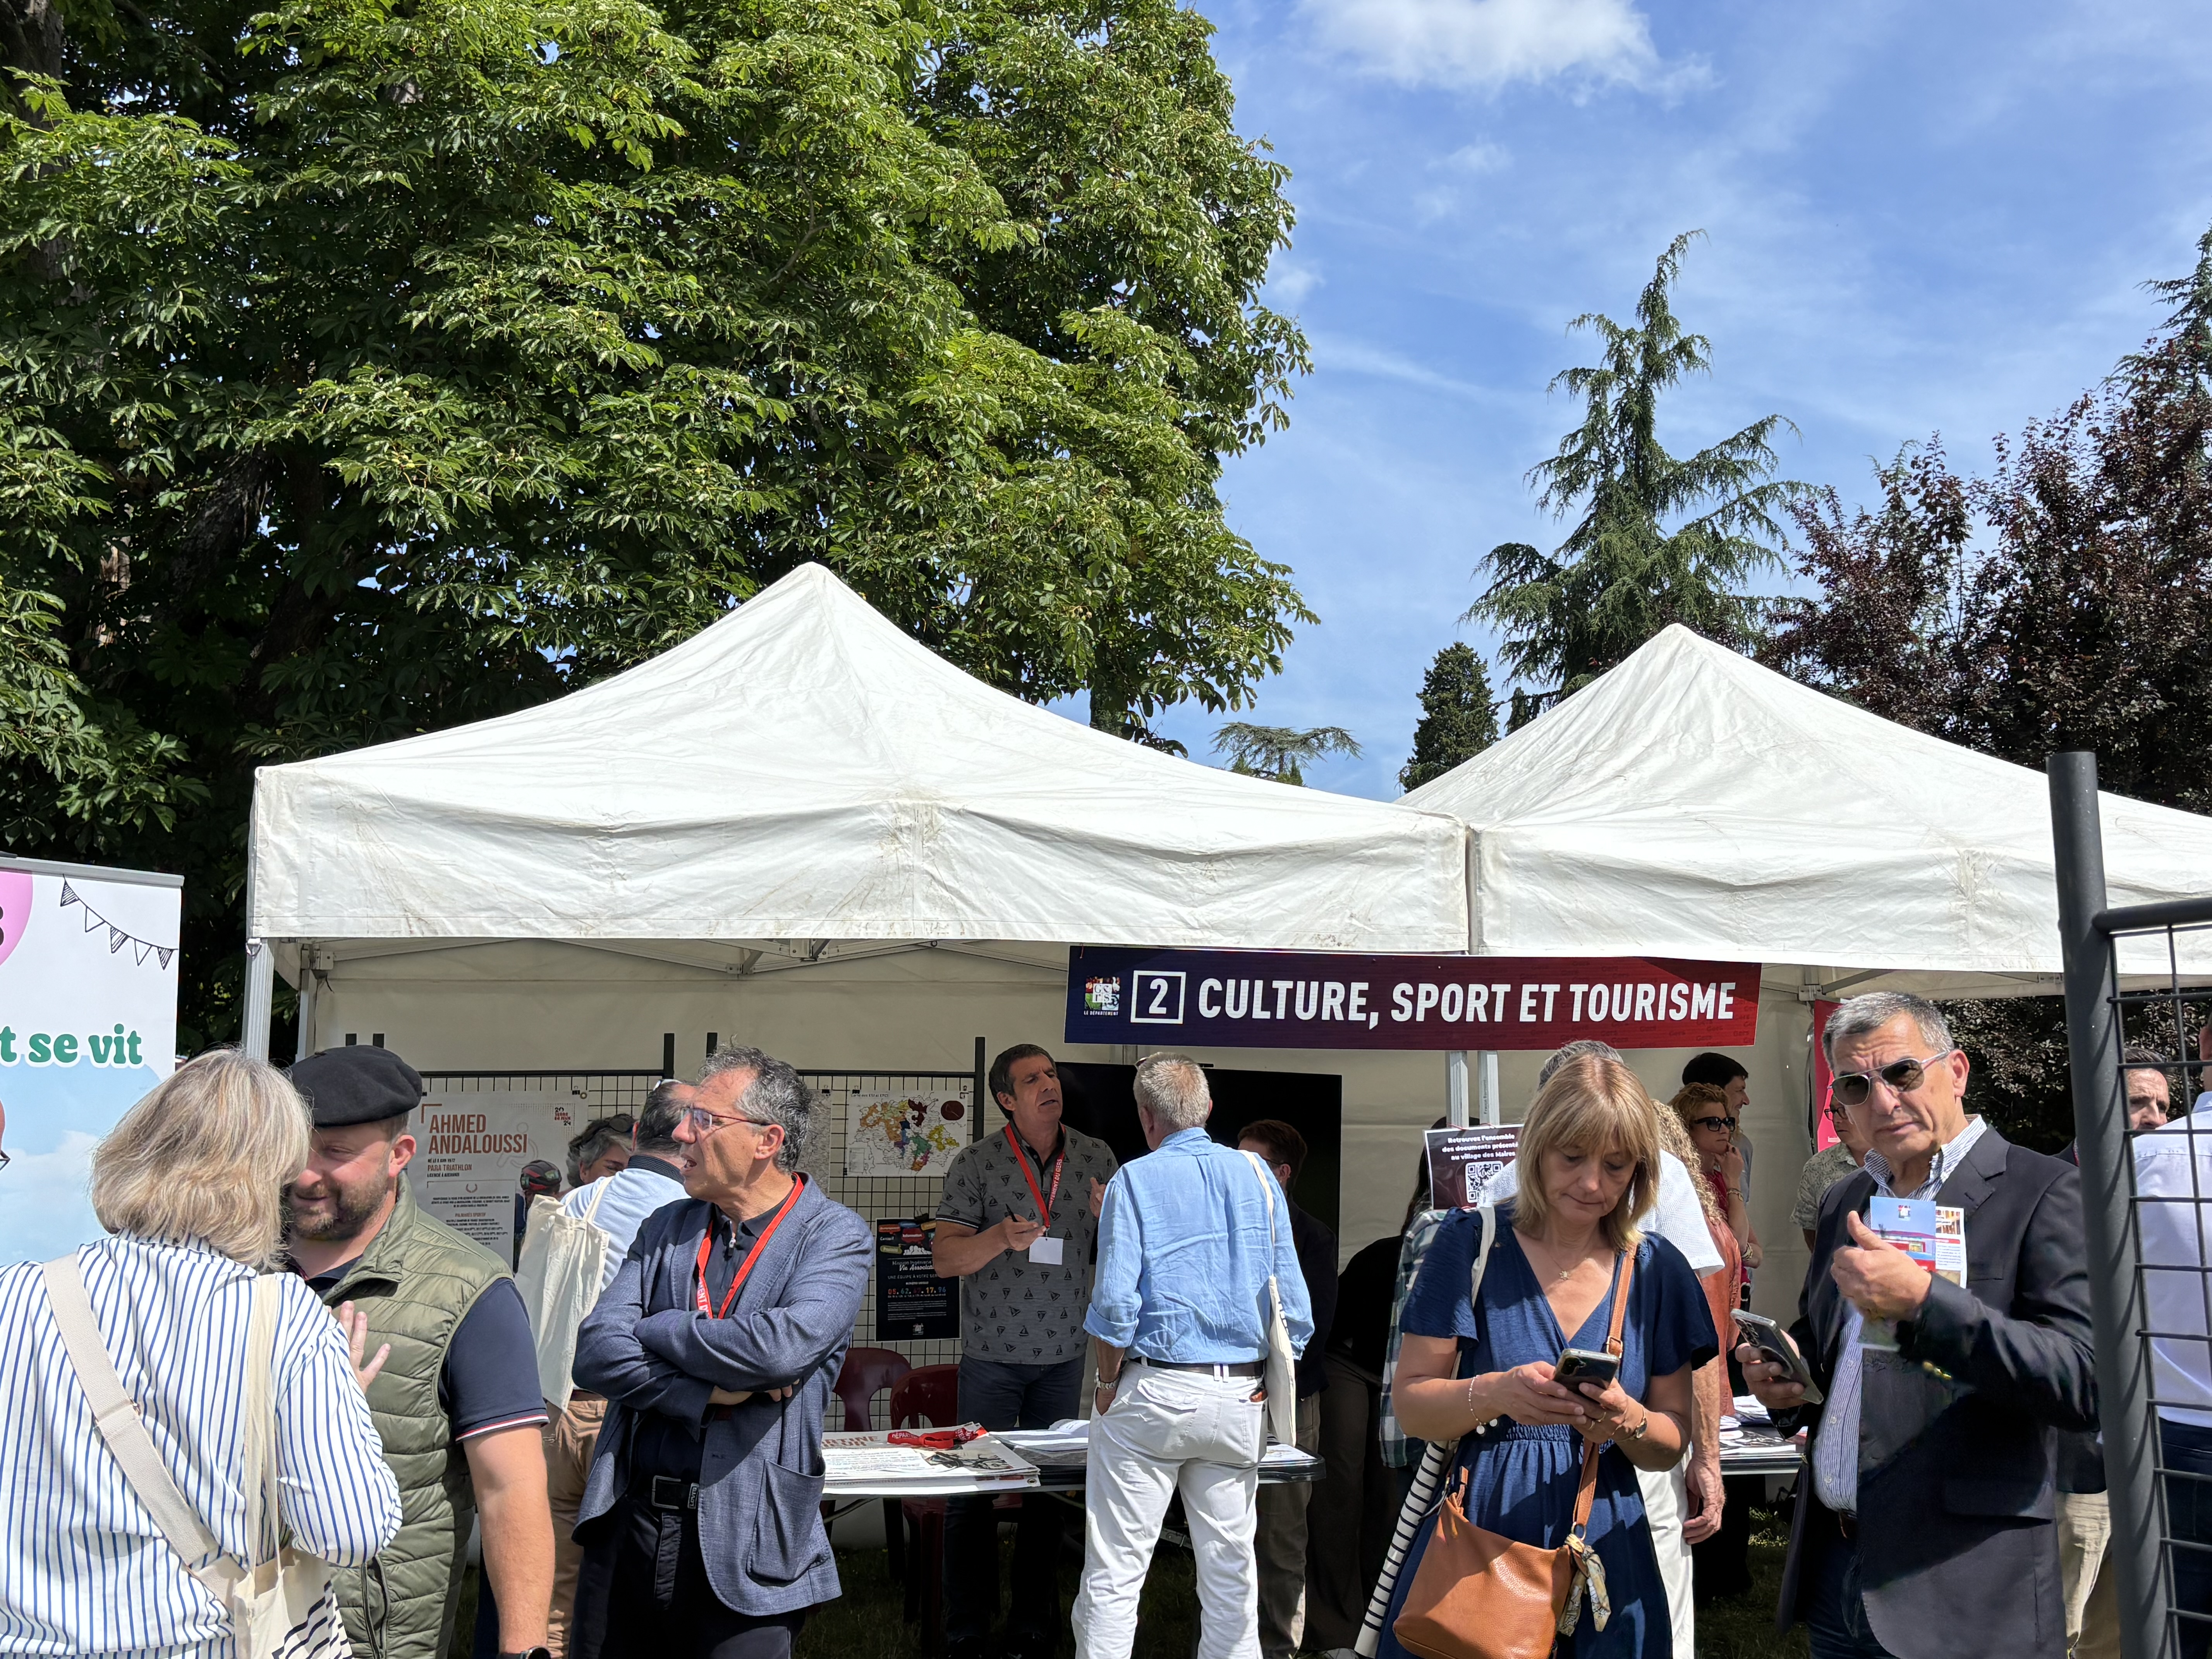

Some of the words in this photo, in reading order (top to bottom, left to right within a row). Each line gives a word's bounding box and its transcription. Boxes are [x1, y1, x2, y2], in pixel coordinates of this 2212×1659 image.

[1149, 978, 1168, 1014] 2
[1199, 977, 1379, 1030] CULTURE,
[1392, 981, 1511, 1023] SPORT
[1519, 984, 1560, 1022] ET
[1570, 982, 1736, 1022] TOURISME
[0, 1026, 17, 1062] t
[29, 1034, 78, 1063] se
[88, 1024, 143, 1065] vit
[429, 1114, 486, 1133] AHMED
[429, 1134, 527, 1154] ANDALOUSSI
[1482, 1133, 1515, 1142] l'ensemble
[1492, 1142, 1518, 1151] présenté
[822, 1436, 880, 1445] RTINE
